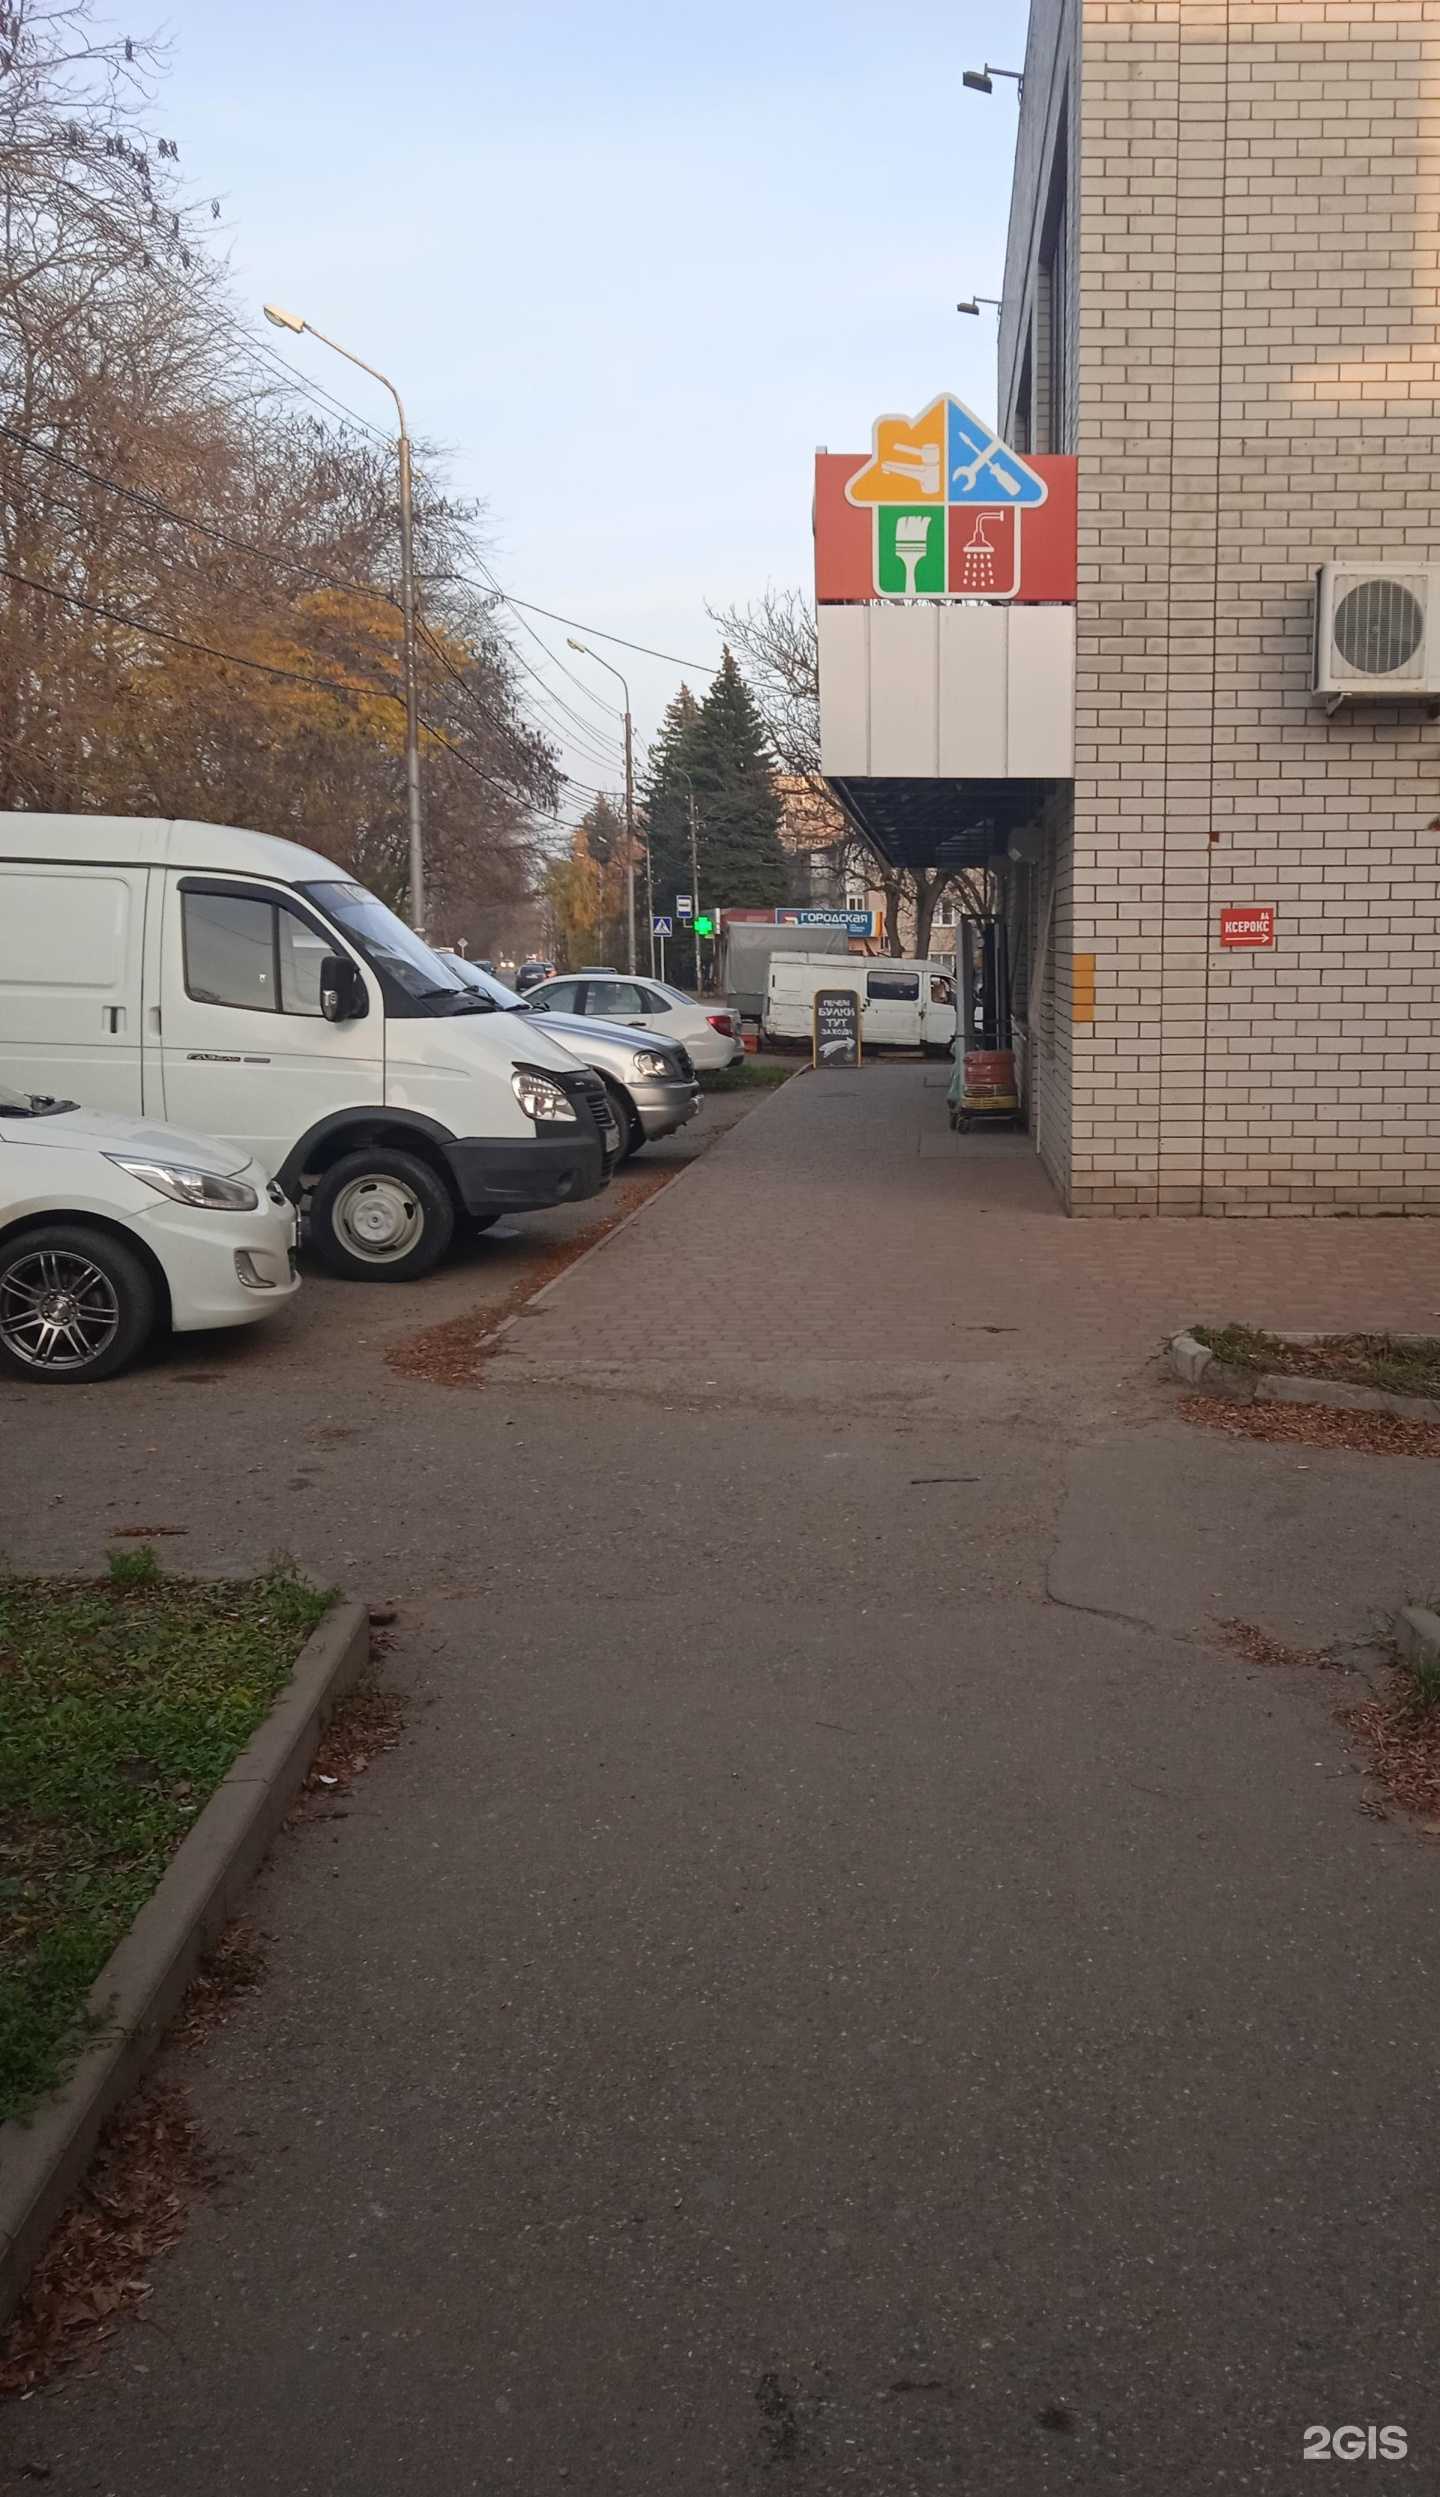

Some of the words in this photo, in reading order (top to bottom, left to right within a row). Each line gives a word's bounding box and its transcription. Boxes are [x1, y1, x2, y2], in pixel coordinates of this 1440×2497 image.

[1225, 921, 1270, 933] КСЕРОКС
[818, 1007, 855, 1017] БУЛКИ
[825, 1018, 848, 1027] ТУТ
